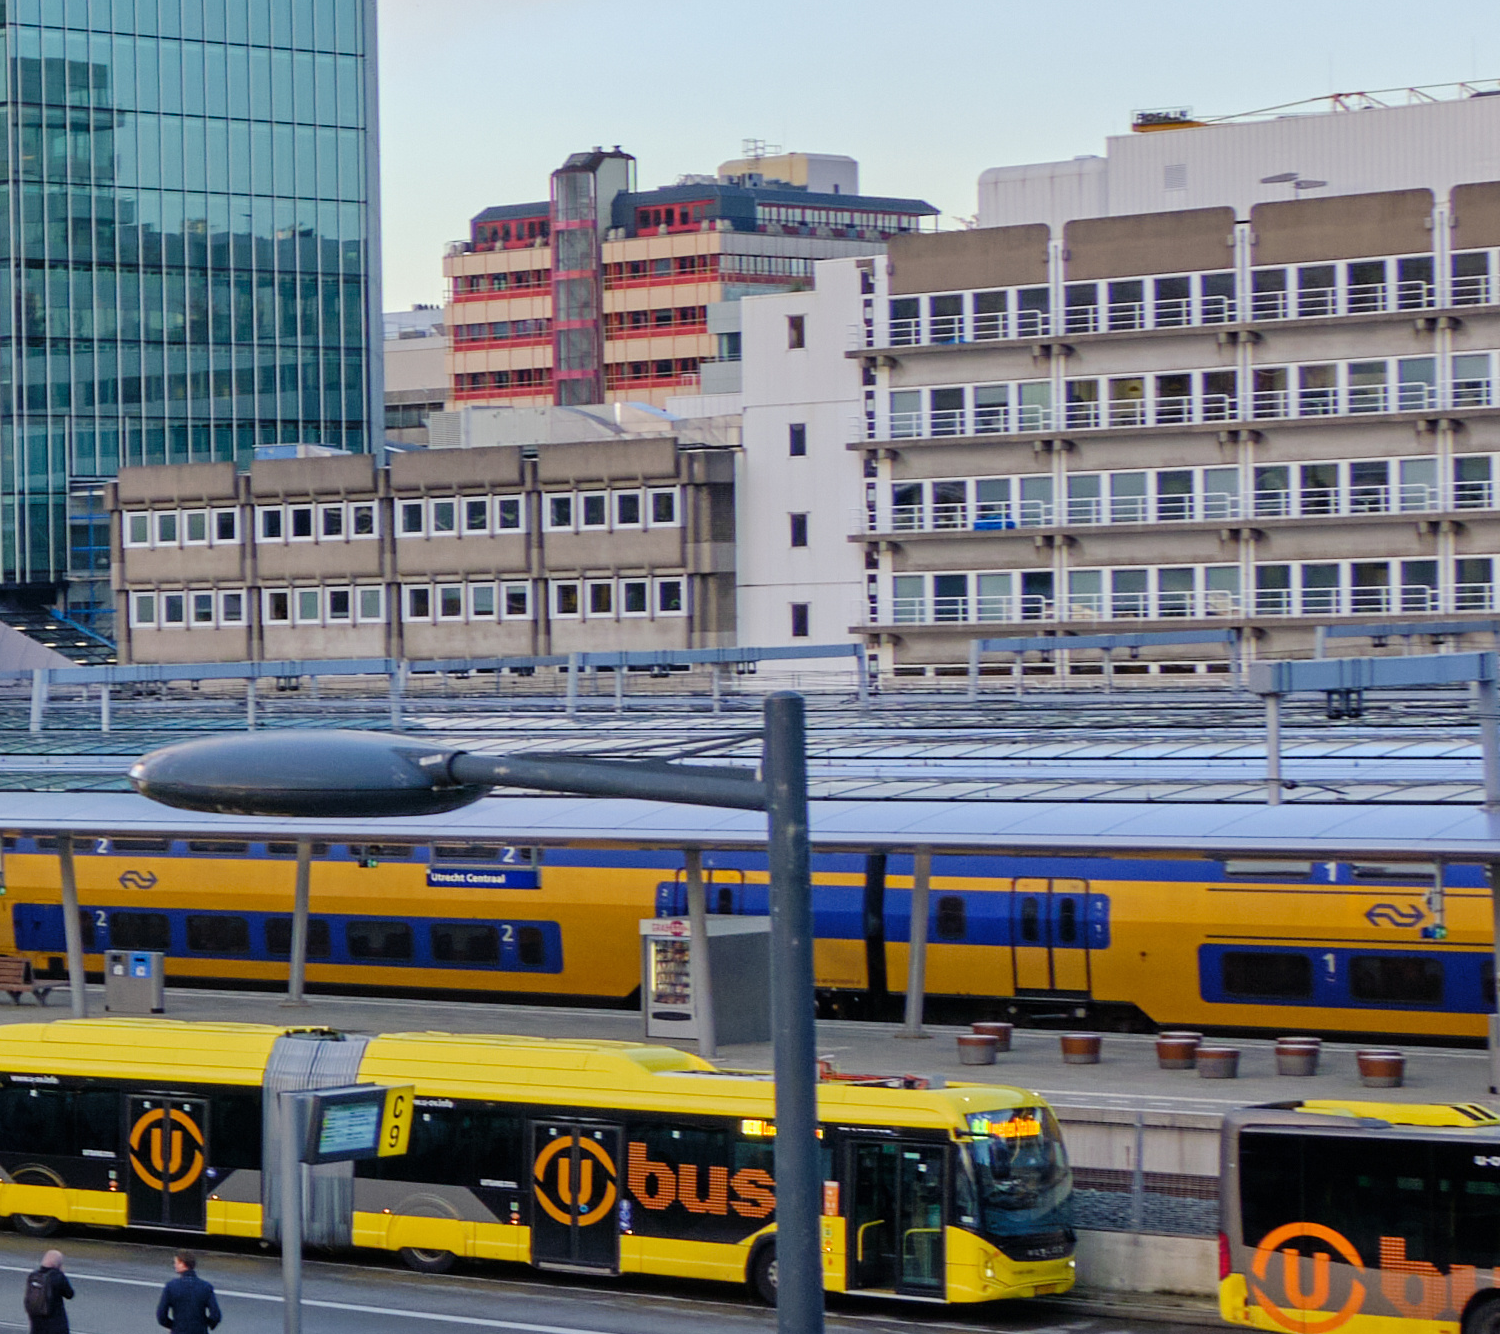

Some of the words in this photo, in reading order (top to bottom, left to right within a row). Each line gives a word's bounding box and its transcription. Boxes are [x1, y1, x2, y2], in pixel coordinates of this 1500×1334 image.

[97, 838, 108, 853] 2
[502, 847, 515, 863] 2
[430, 873, 465, 883] Utrecht
[466, 873, 506, 884] Centraal
[1324, 862, 1337, 882] 1
[96, 910, 108, 926] 2
[501, 925, 514, 942] 2
[1322, 953, 1336, 973] 1
[393, 1095, 404, 1118] C
[388, 1124, 399, 1149] 9
[627, 1141, 777, 1218] bus
